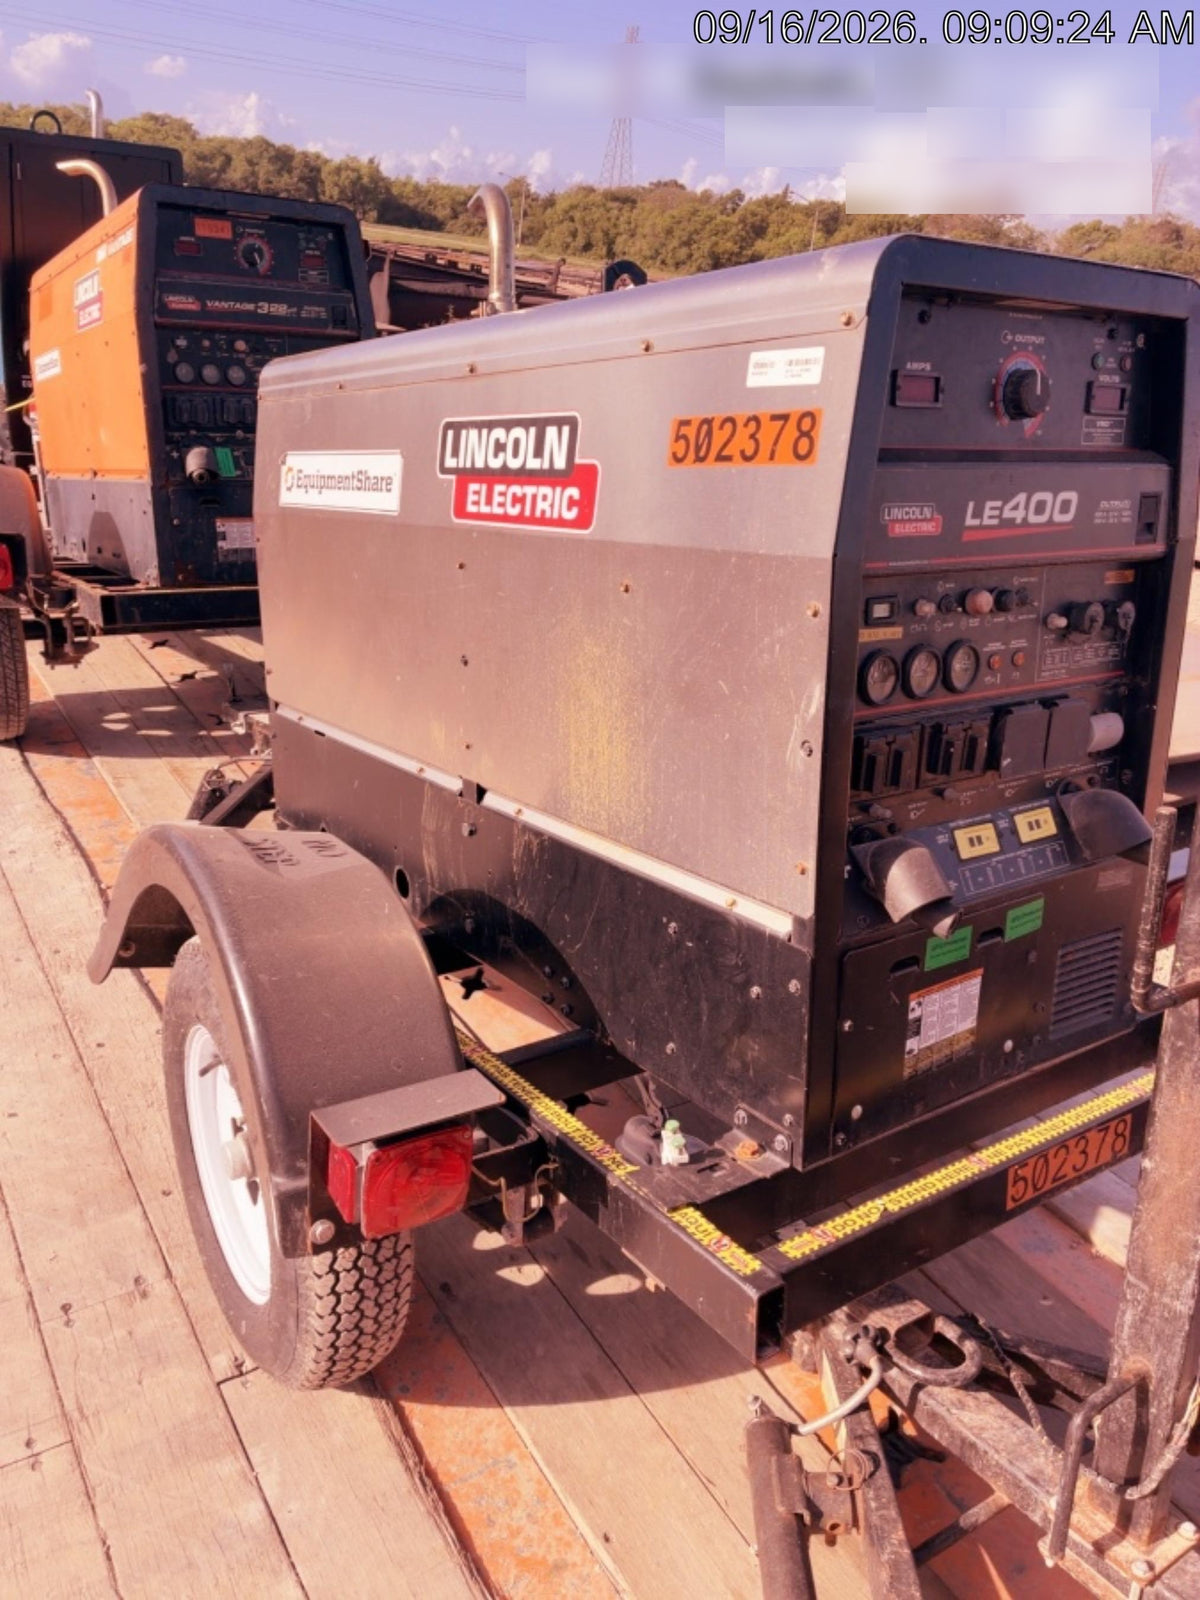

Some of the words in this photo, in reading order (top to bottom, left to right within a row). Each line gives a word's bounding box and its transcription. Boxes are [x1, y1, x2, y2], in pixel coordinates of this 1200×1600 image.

[206, 300, 256, 311] VANTAGE
[1015, 335, 1045, 345] OUTPUT
[906, 361, 932, 371] AMPS
[443, 424, 570, 471] LINCOLN
[671, 410, 818, 465] 502378
[296, 468, 394, 495] EquipmentShare
[465, 482, 581, 520] ELECTRIC
[884, 506, 933, 520] LINCOLN
[965, 490, 1079, 527] LE400
[893, 521, 937, 535] ELECTRIC
[1010, 1119, 1129, 1203] 502378
[831, 1217, 857, 1233] DO
[888, 1181, 937, 1206] STAND
[938, 1163, 972, 1183] HERE
